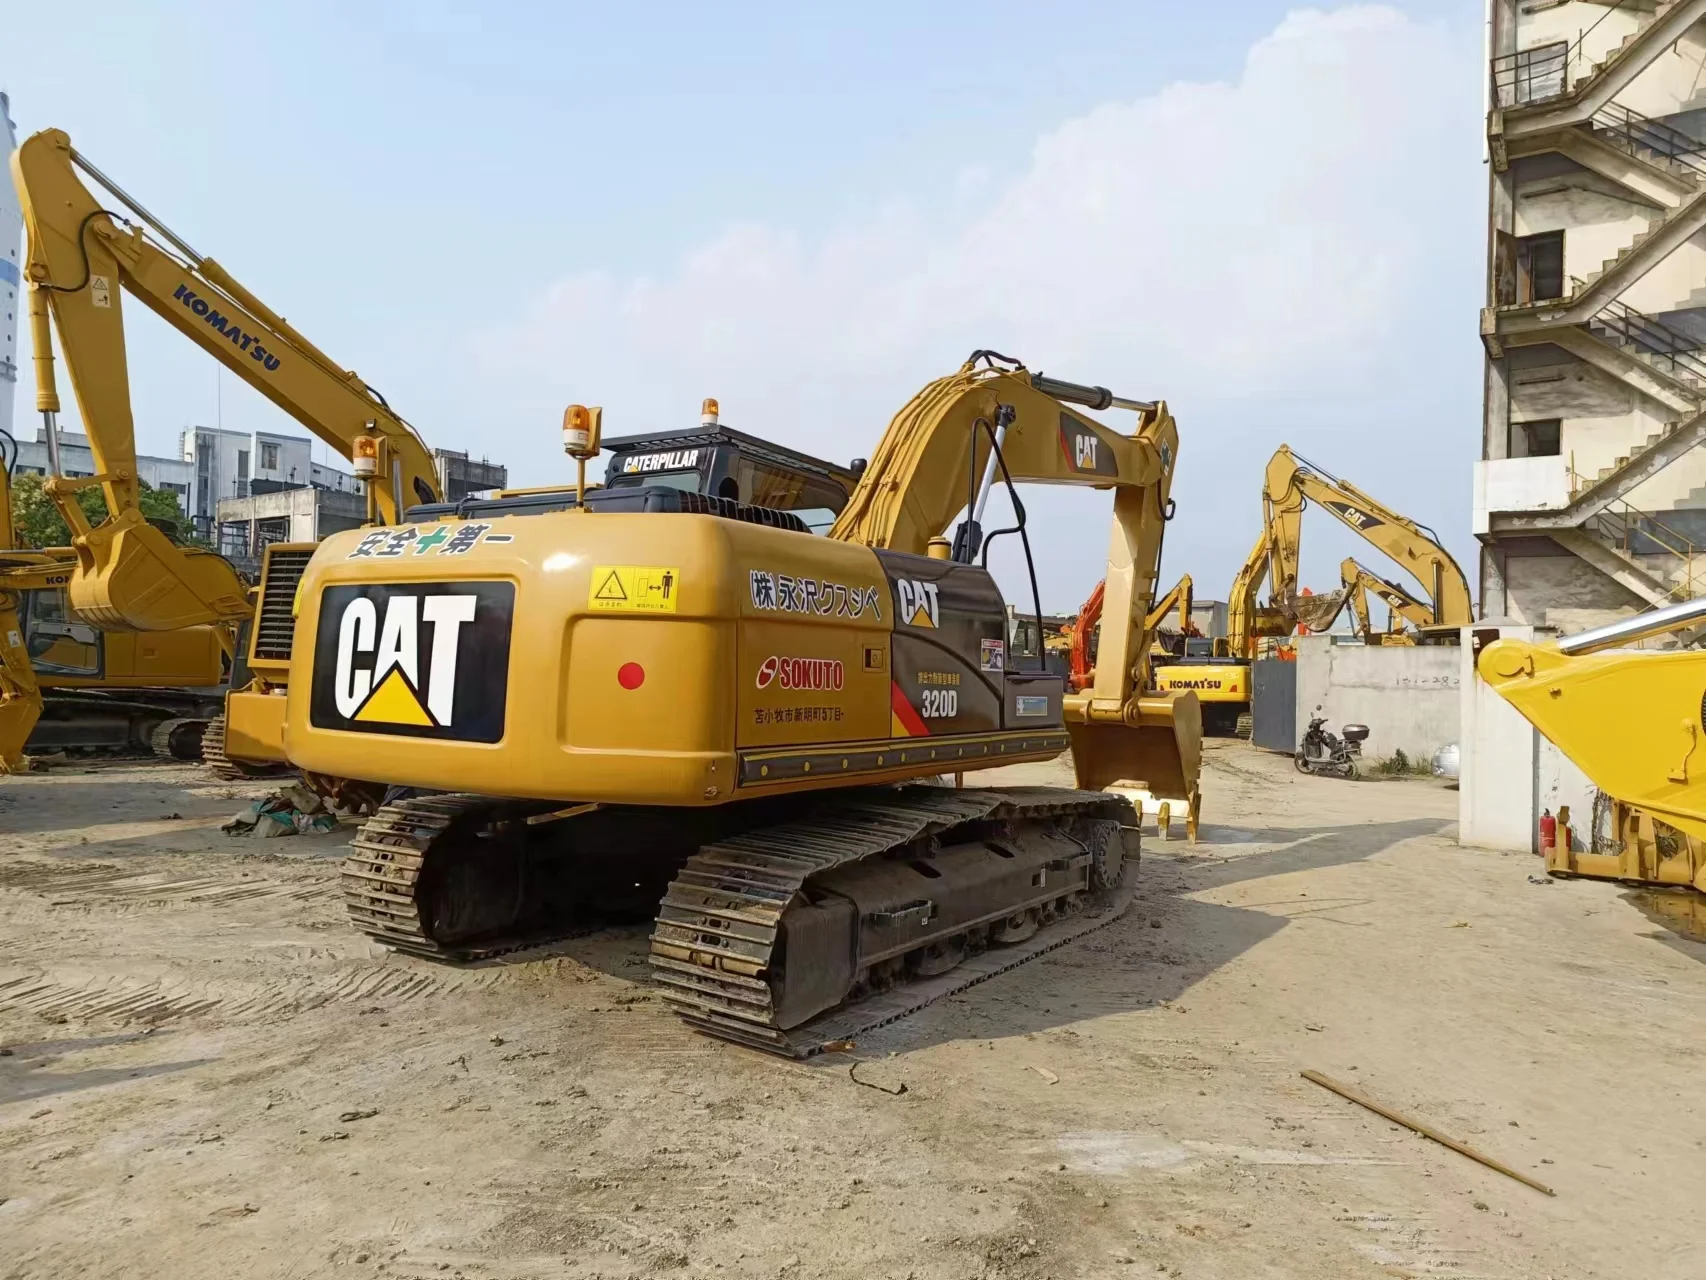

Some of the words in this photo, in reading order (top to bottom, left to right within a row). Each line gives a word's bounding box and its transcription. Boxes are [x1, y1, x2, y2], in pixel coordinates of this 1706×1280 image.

[172, 283, 281, 372] KOMATSU
[623, 449, 699, 473] CATERPILLAR
[1075, 434, 1098, 469] CAT
[1343, 507, 1367, 529] CAT
[897, 578, 939, 628] CAT
[1387, 594, 1403, 608] CAT
[335, 594, 478, 727] CAT
[779, 656, 844, 691] SOKUTO
[1169, 677, 1222, 690] KOMATSU
[921, 689, 958, 719] 320D
